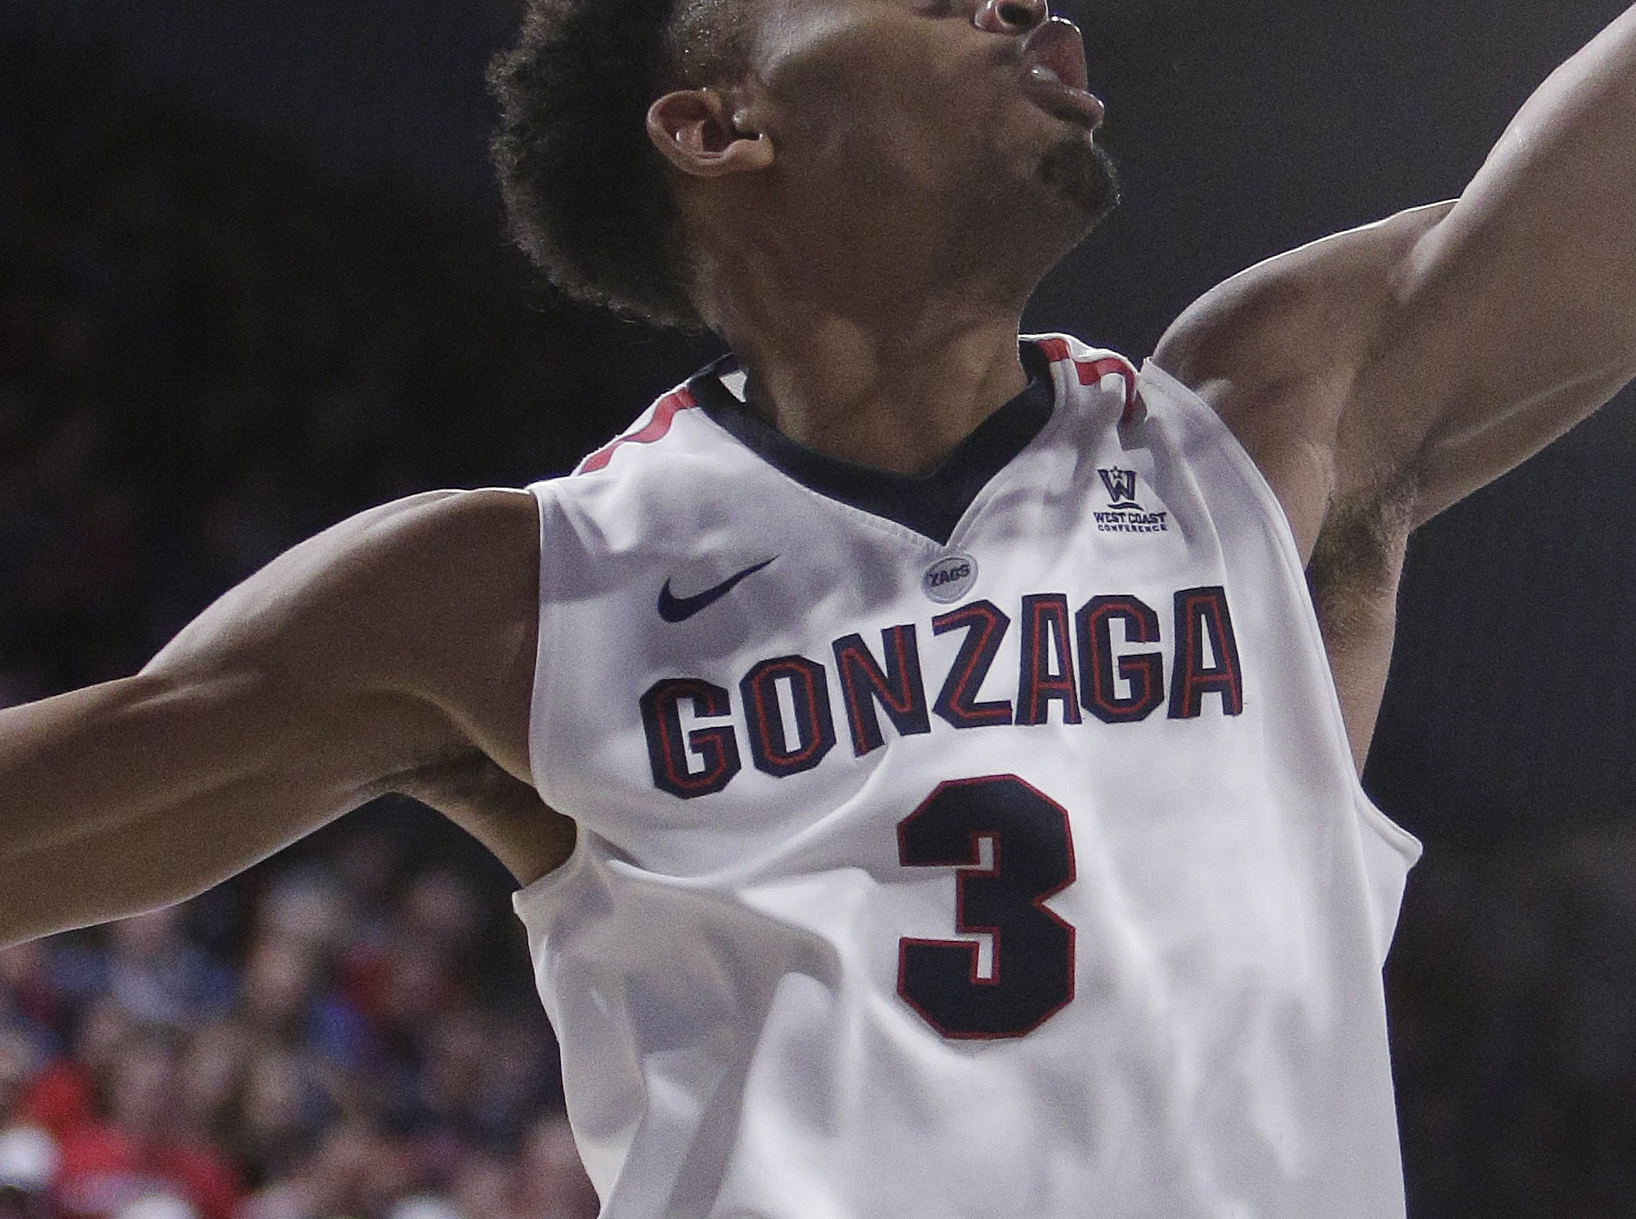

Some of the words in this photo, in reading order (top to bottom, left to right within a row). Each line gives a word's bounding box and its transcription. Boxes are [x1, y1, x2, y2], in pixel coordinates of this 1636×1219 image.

[1093, 511, 1126, 524] WEST
[1127, 511, 1167, 524] COAST
[1097, 523, 1168, 533] CONFERENCE
[929, 564, 970, 587] ZAGS
[640, 587, 1243, 801] GONZAGA
[896, 774, 1077, 1039] 3
